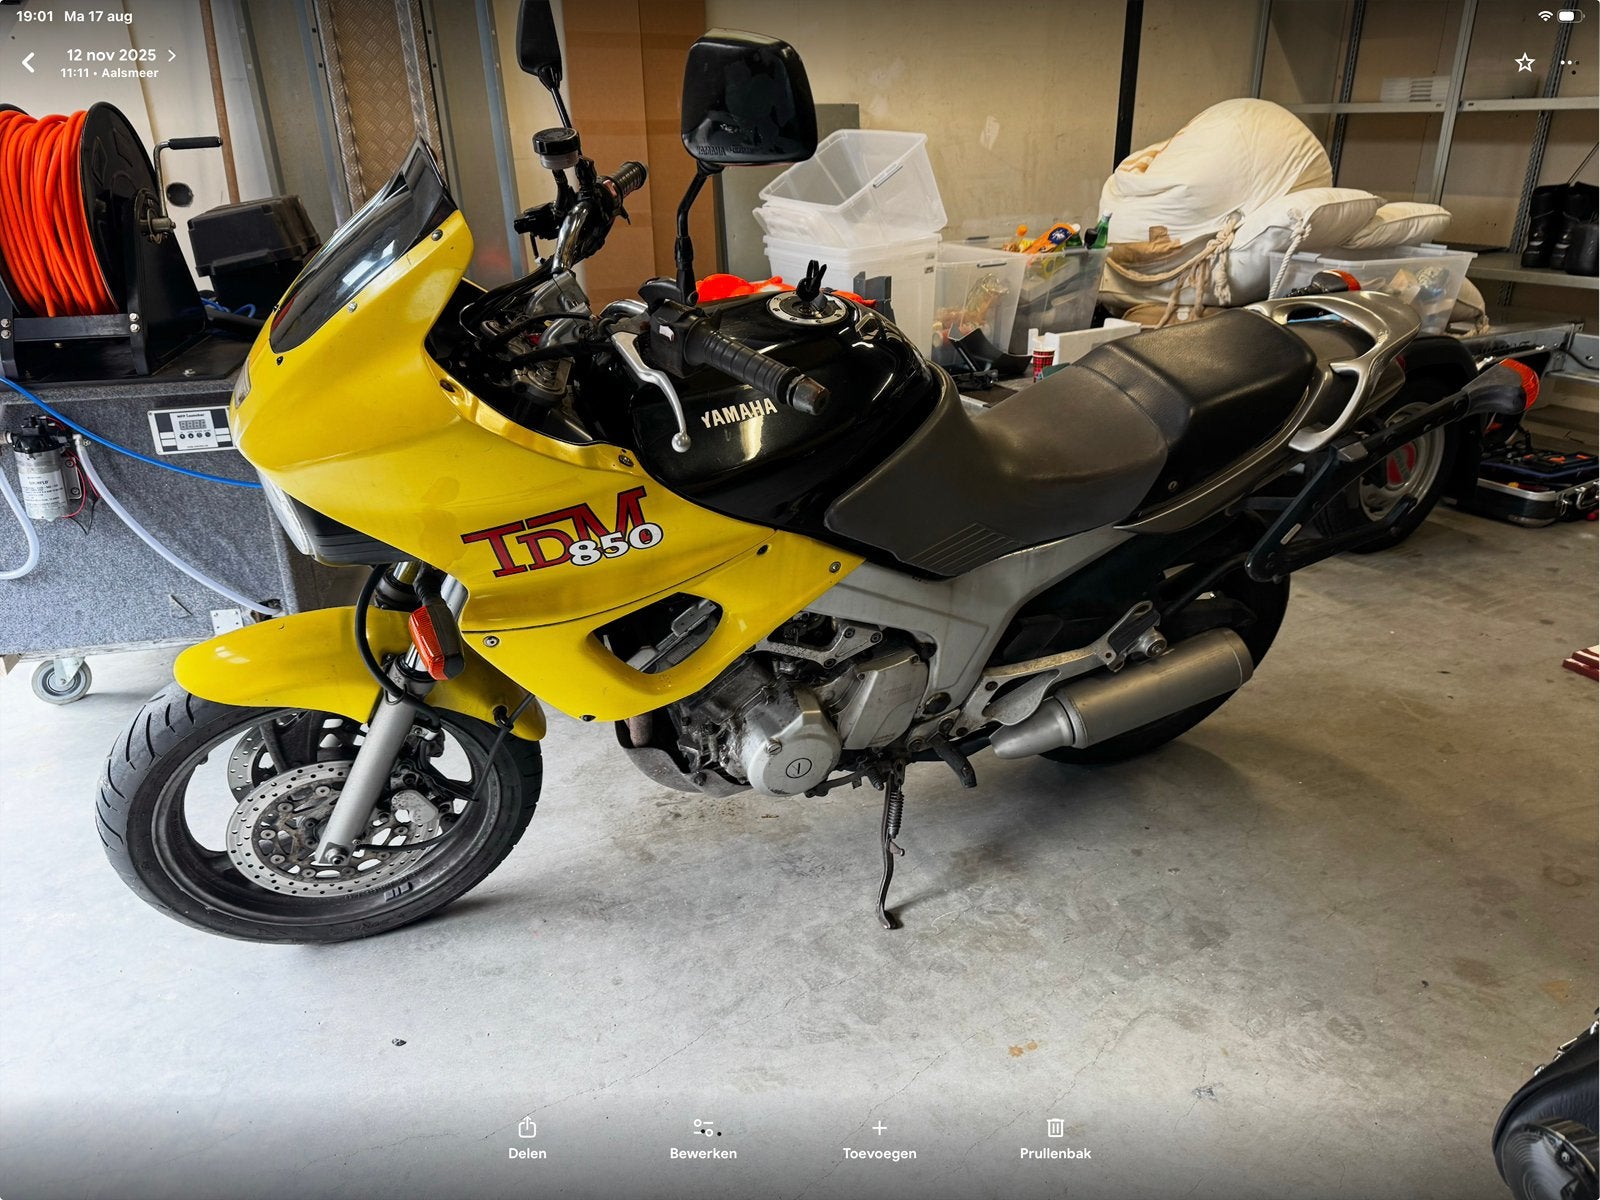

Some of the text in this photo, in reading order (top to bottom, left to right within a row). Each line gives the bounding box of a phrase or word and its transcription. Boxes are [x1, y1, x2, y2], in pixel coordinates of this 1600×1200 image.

[701, 398, 778, 429] YAMAHA
[460, 485, 647, 578] TDM
[568, 522, 664, 566] 850
